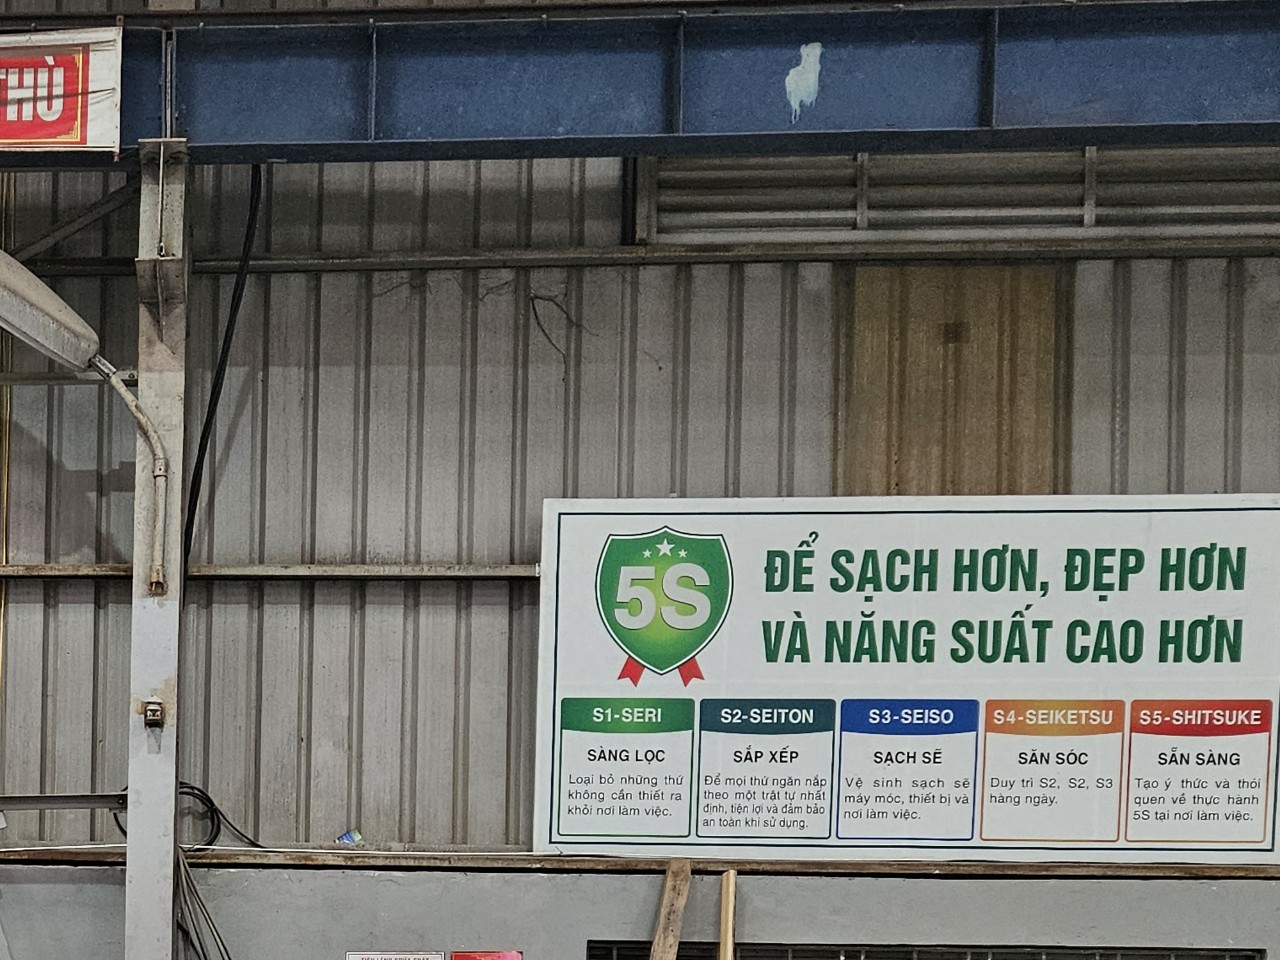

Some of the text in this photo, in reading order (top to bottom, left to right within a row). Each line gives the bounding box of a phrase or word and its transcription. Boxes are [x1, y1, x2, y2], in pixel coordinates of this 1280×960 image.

[764, 531, 1246, 602] ĐỂ SẠCH HƠN, ĐẸP HƠN
[613, 562, 712, 631] 5S
[762, 604, 1242, 663] VÀ NĂNG SUẤT CAO HƠN
[593, 708, 662, 722] S1-SERI
[721, 709, 813, 723] S2-SEITON
[869, 709, 953, 723] S3-SEISO
[994, 710, 1113, 724] S4-SEIKETSU
[1140, 710, 1261, 724] S5-SHITSUKE
[588, 746, 665, 764] SÀNG LỌC
[734, 745, 798, 763] SẮP XẾP
[874, 749, 942, 766] SẠCH SẼ
[1019, 749, 1088, 764] SĂN SÓC
[1158, 747, 1240, 765] SẴN SÀNG
[569, 774, 683, 787] Loại bỏ những thứ
[705, 773, 720, 785] Để
[725, 776, 746, 787] mọi
[751, 776, 768, 786] thứ
[772, 777, 800, 788] ngăn
[845, 778, 970, 789] Vệ sinh sạch sẽ
[991, 778, 1112, 790] Duy trì S2, S2, S3
[1135, 778, 1158, 790] Tạo
[1165, 778, 1171, 791] ý
[1181, 778, 1207, 788] thức
[1215, 779, 1230, 789] và
[568, 790, 604, 802] không
[639, 789, 664, 800] thiết
[671, 793, 682, 801] ra
[704, 787, 825, 801] theo một trật tự nhất
[845, 792, 968, 806] máy móc, thiết bị và
[990, 793, 1057, 806] hàng ngày.
[1134, 797, 1165, 806] quen
[1193, 795, 1219, 805] thực
[1228, 795, 1258, 804] hành
[568, 804, 671, 817] khỏi nơi làm việc.
[703, 803, 825, 815] định, tiện lợi và đảm bảo
[844, 809, 920, 820] nơi làm việc.
[1133, 810, 1253, 822] 5S tại nơi làm việc.
[719, 817, 741, 827] toàn
[745, 817, 760, 827] khi
[764, 816, 776, 827] sử
[779, 818, 808, 830] dụng.
